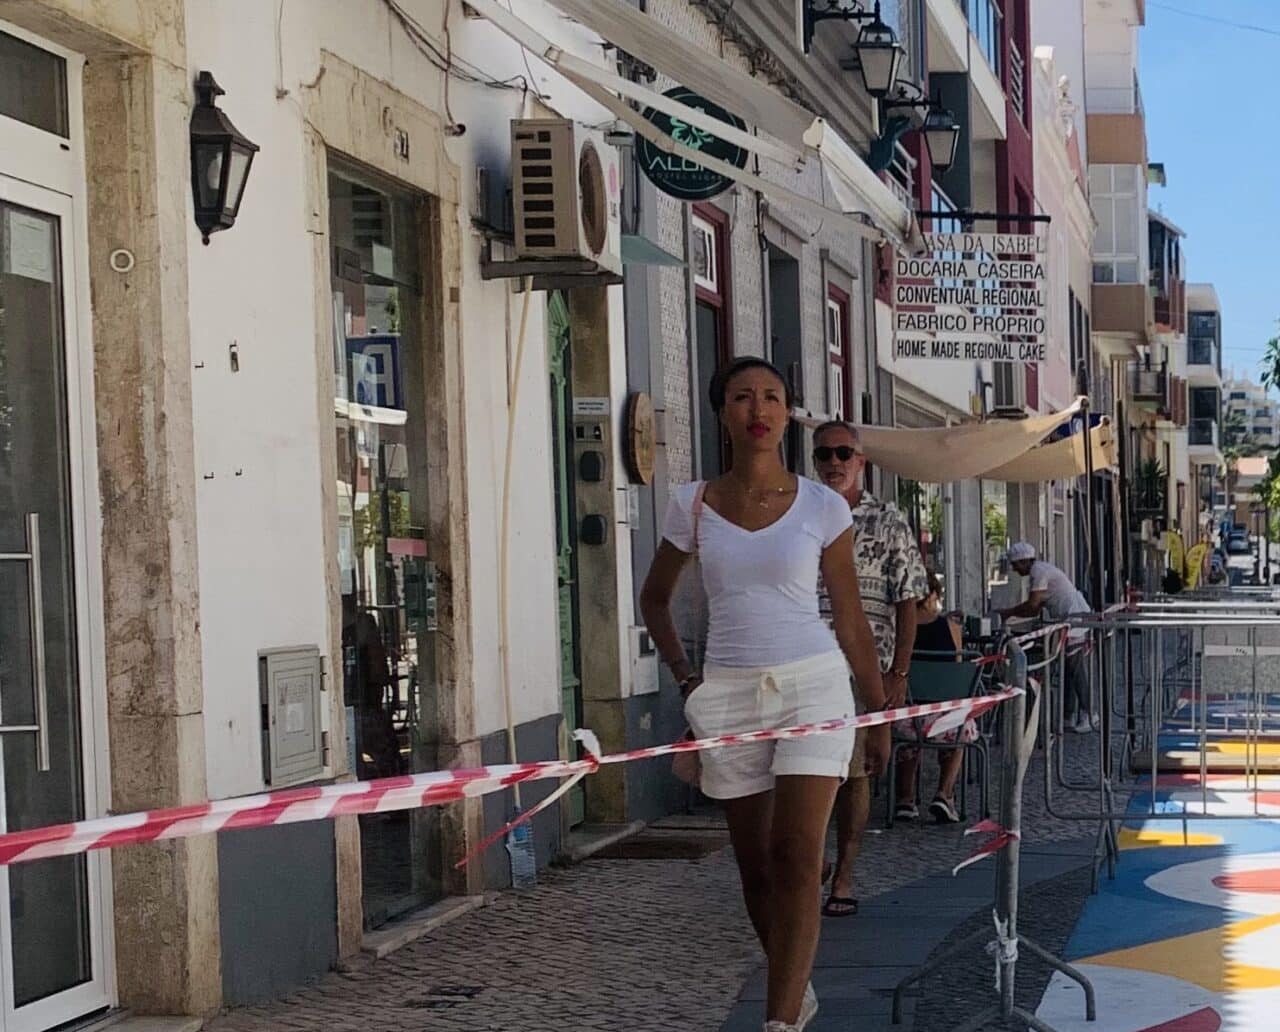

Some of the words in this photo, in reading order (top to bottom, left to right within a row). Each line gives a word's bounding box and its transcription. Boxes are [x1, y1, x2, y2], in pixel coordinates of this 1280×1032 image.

[927, 235, 956, 253] ASA
[963, 235, 985, 253] DA
[977, 261, 1045, 279] CASEIRA
[897, 286, 979, 305] CONVENTUAL
[982, 288, 1044, 307] REGIONAL
[897, 313, 967, 331] FABRICO
[896, 339, 927, 357] HOME
[930, 340, 960, 358] MADE
[964, 341, 1014, 360] REGIONAL
[1018, 343, 1045, 361] CAKE
